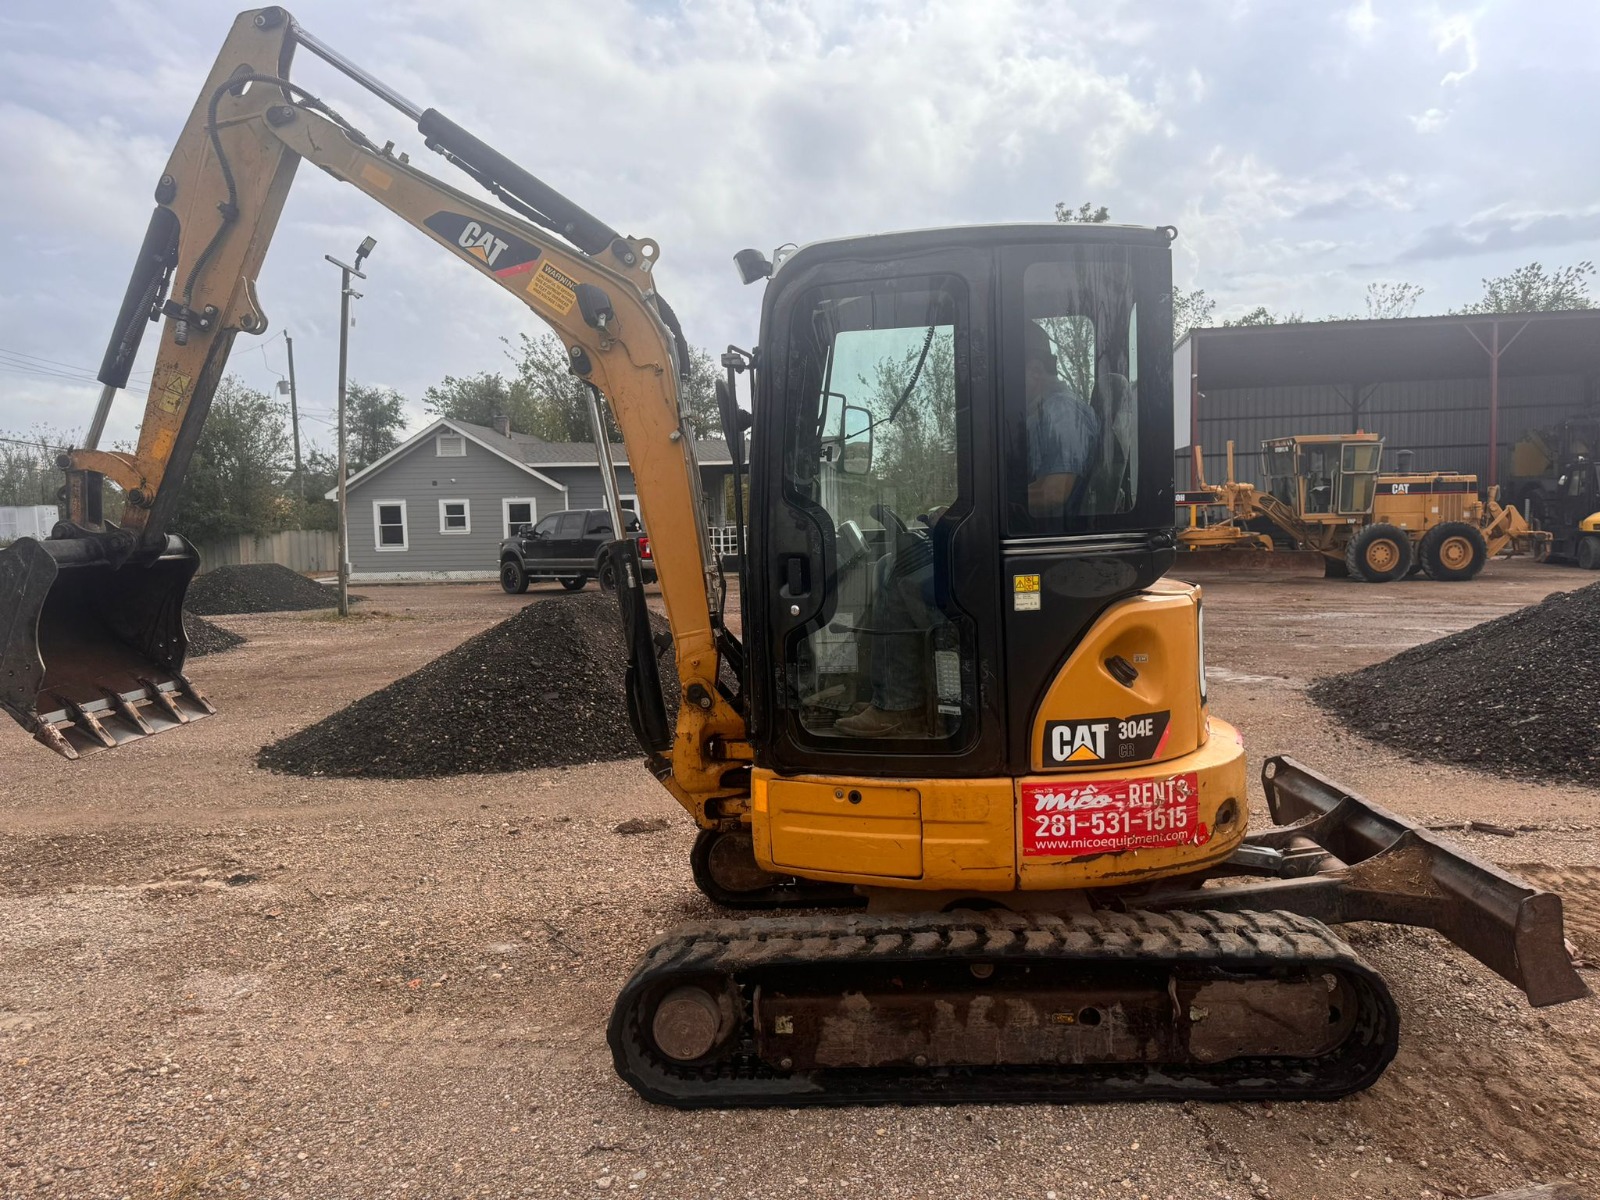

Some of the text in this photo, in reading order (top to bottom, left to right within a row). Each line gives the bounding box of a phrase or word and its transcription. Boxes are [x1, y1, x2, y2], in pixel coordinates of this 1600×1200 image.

[458, 221, 509, 266] CAT
[1392, 483, 1410, 494] CAT
[1051, 718, 1153, 762] CAT 304E
[1119, 742, 1135, 758] CR
[1035, 805, 1187, 837] 281-531-1515
[1035, 830, 1188, 850] www.micoequipment.com
